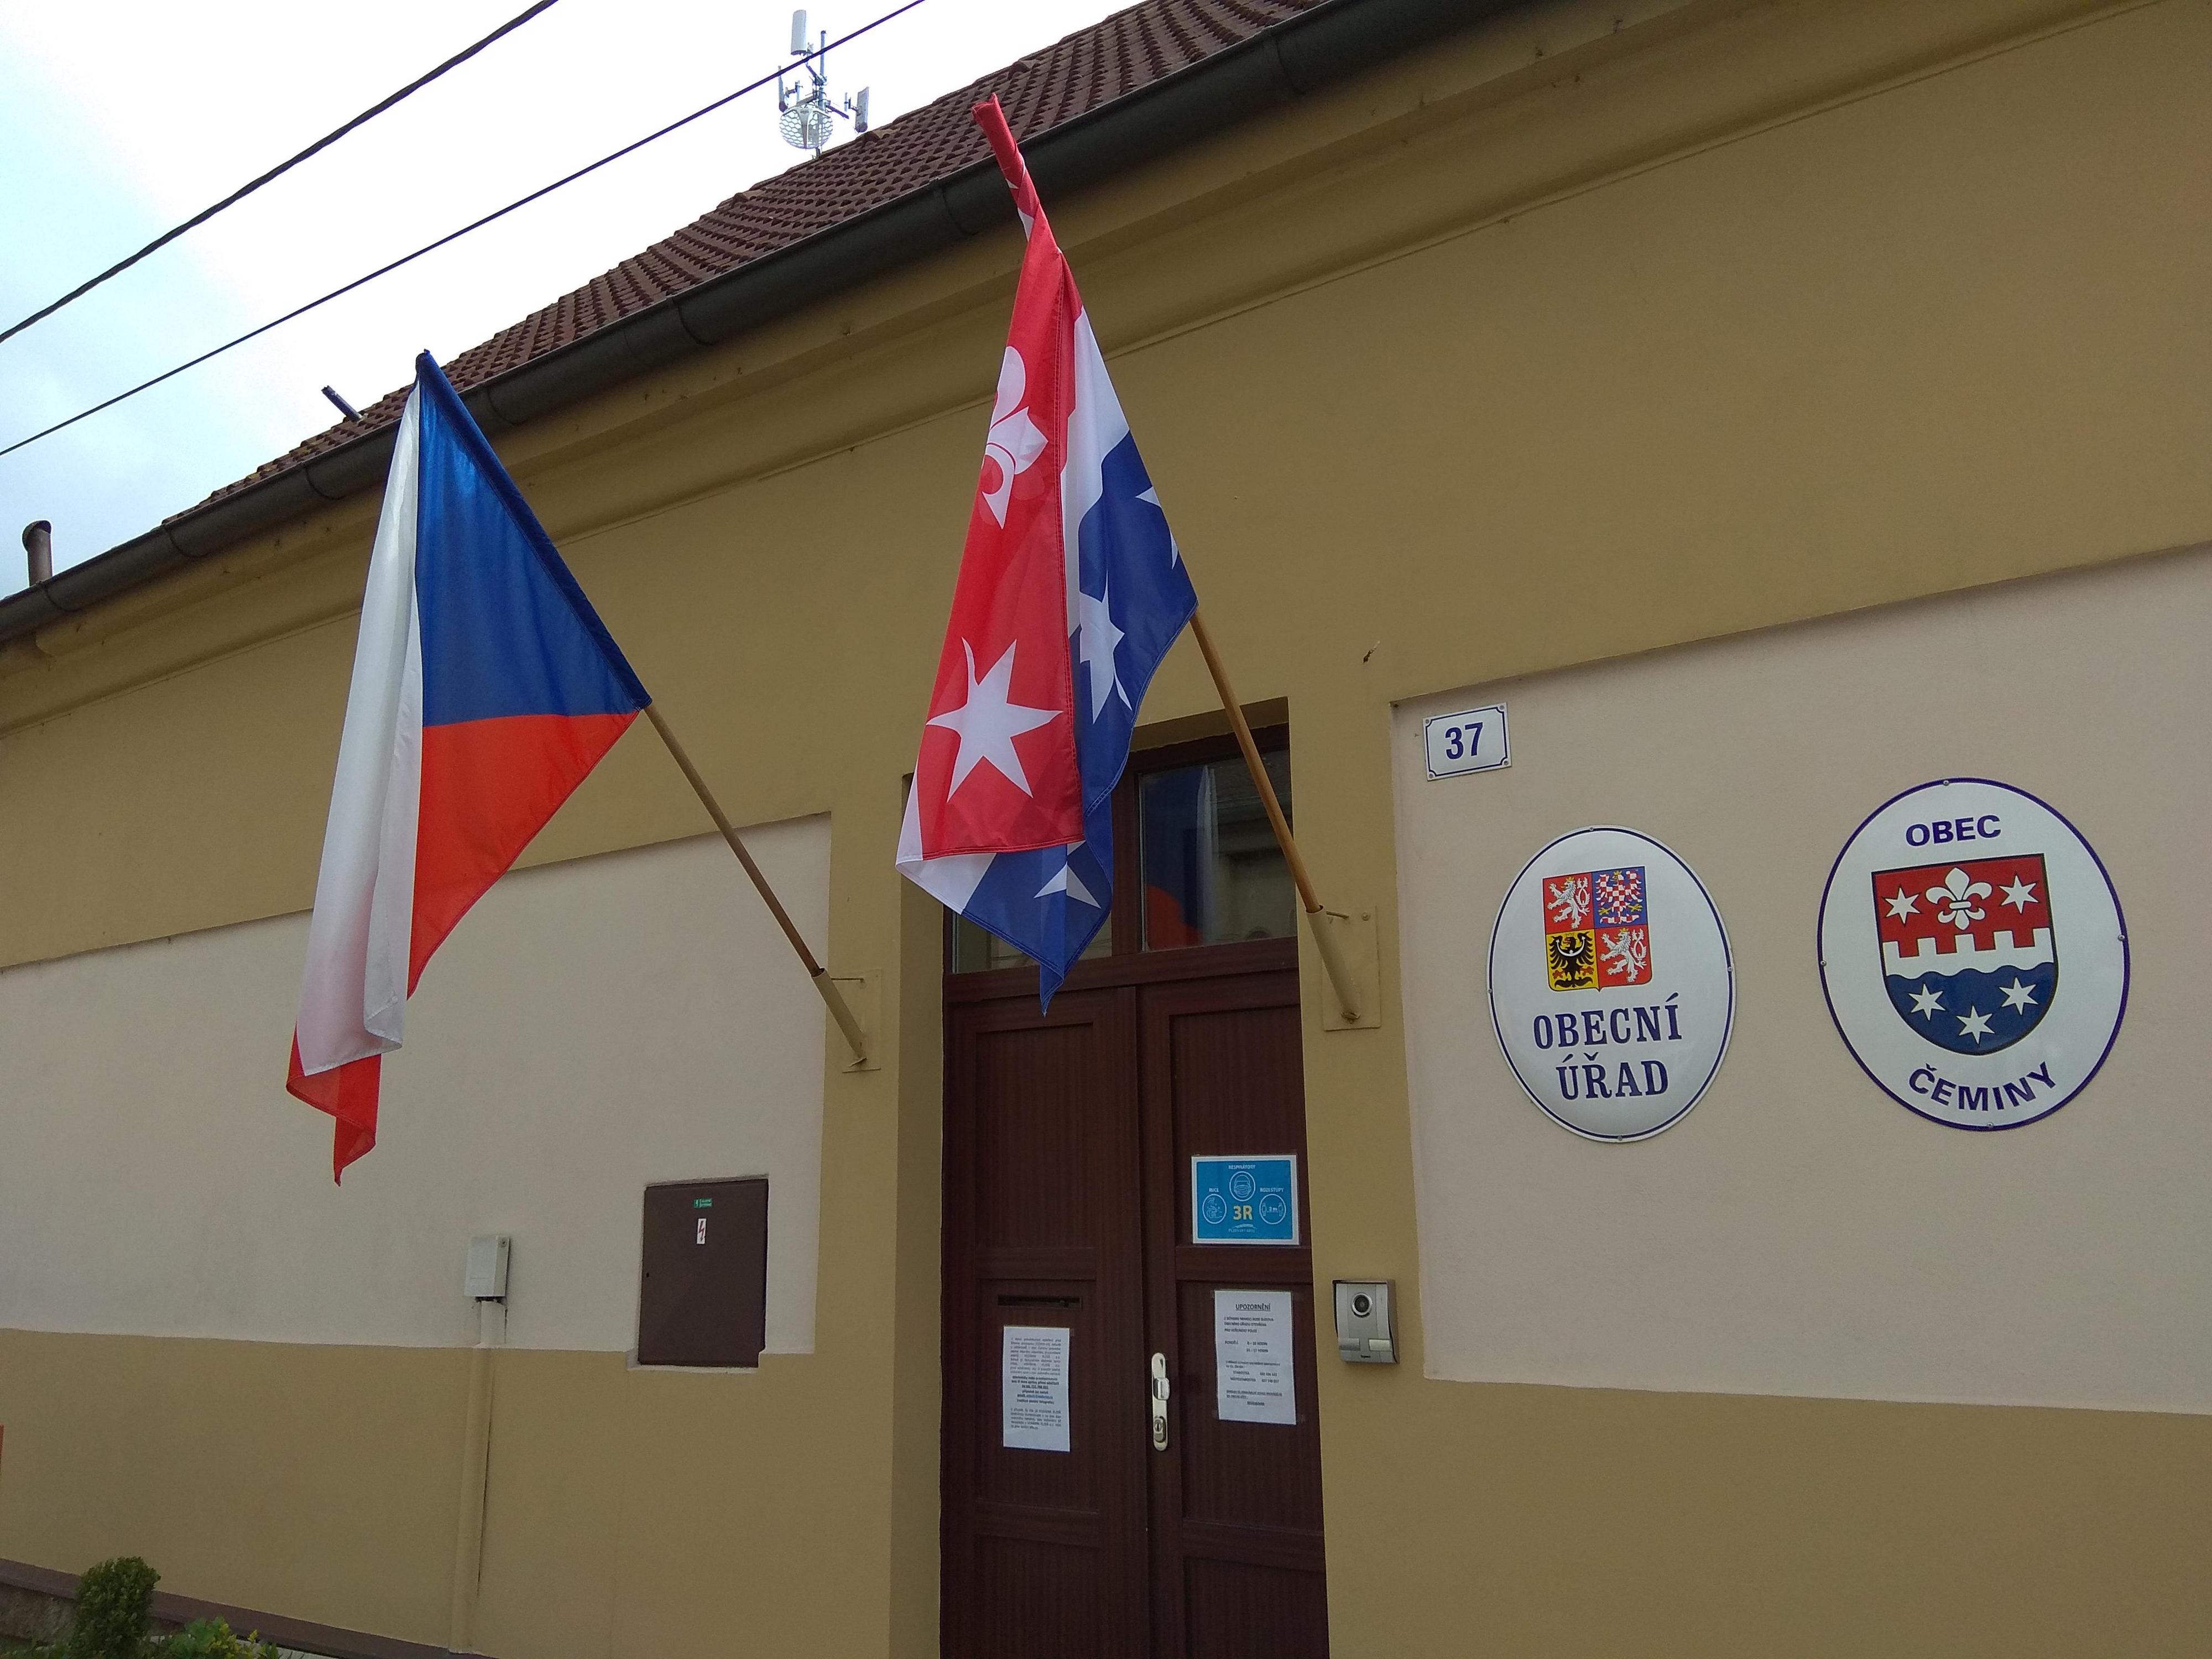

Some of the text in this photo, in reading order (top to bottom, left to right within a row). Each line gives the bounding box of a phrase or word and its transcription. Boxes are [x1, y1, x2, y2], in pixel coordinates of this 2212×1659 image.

[1445, 722, 1483, 759] 37
[1906, 815, 2001, 847] OBEC
[1533, 992, 1682, 1049] OBECNÍ
[1556, 1051, 1669, 1100] ÚŘAD
[1908, 1062, 2057, 1112] ČEMINY
[1233, 1205, 1253, 1220] 3R
[1235, 1303, 1271, 1311] UPOZORNĚNÍ
